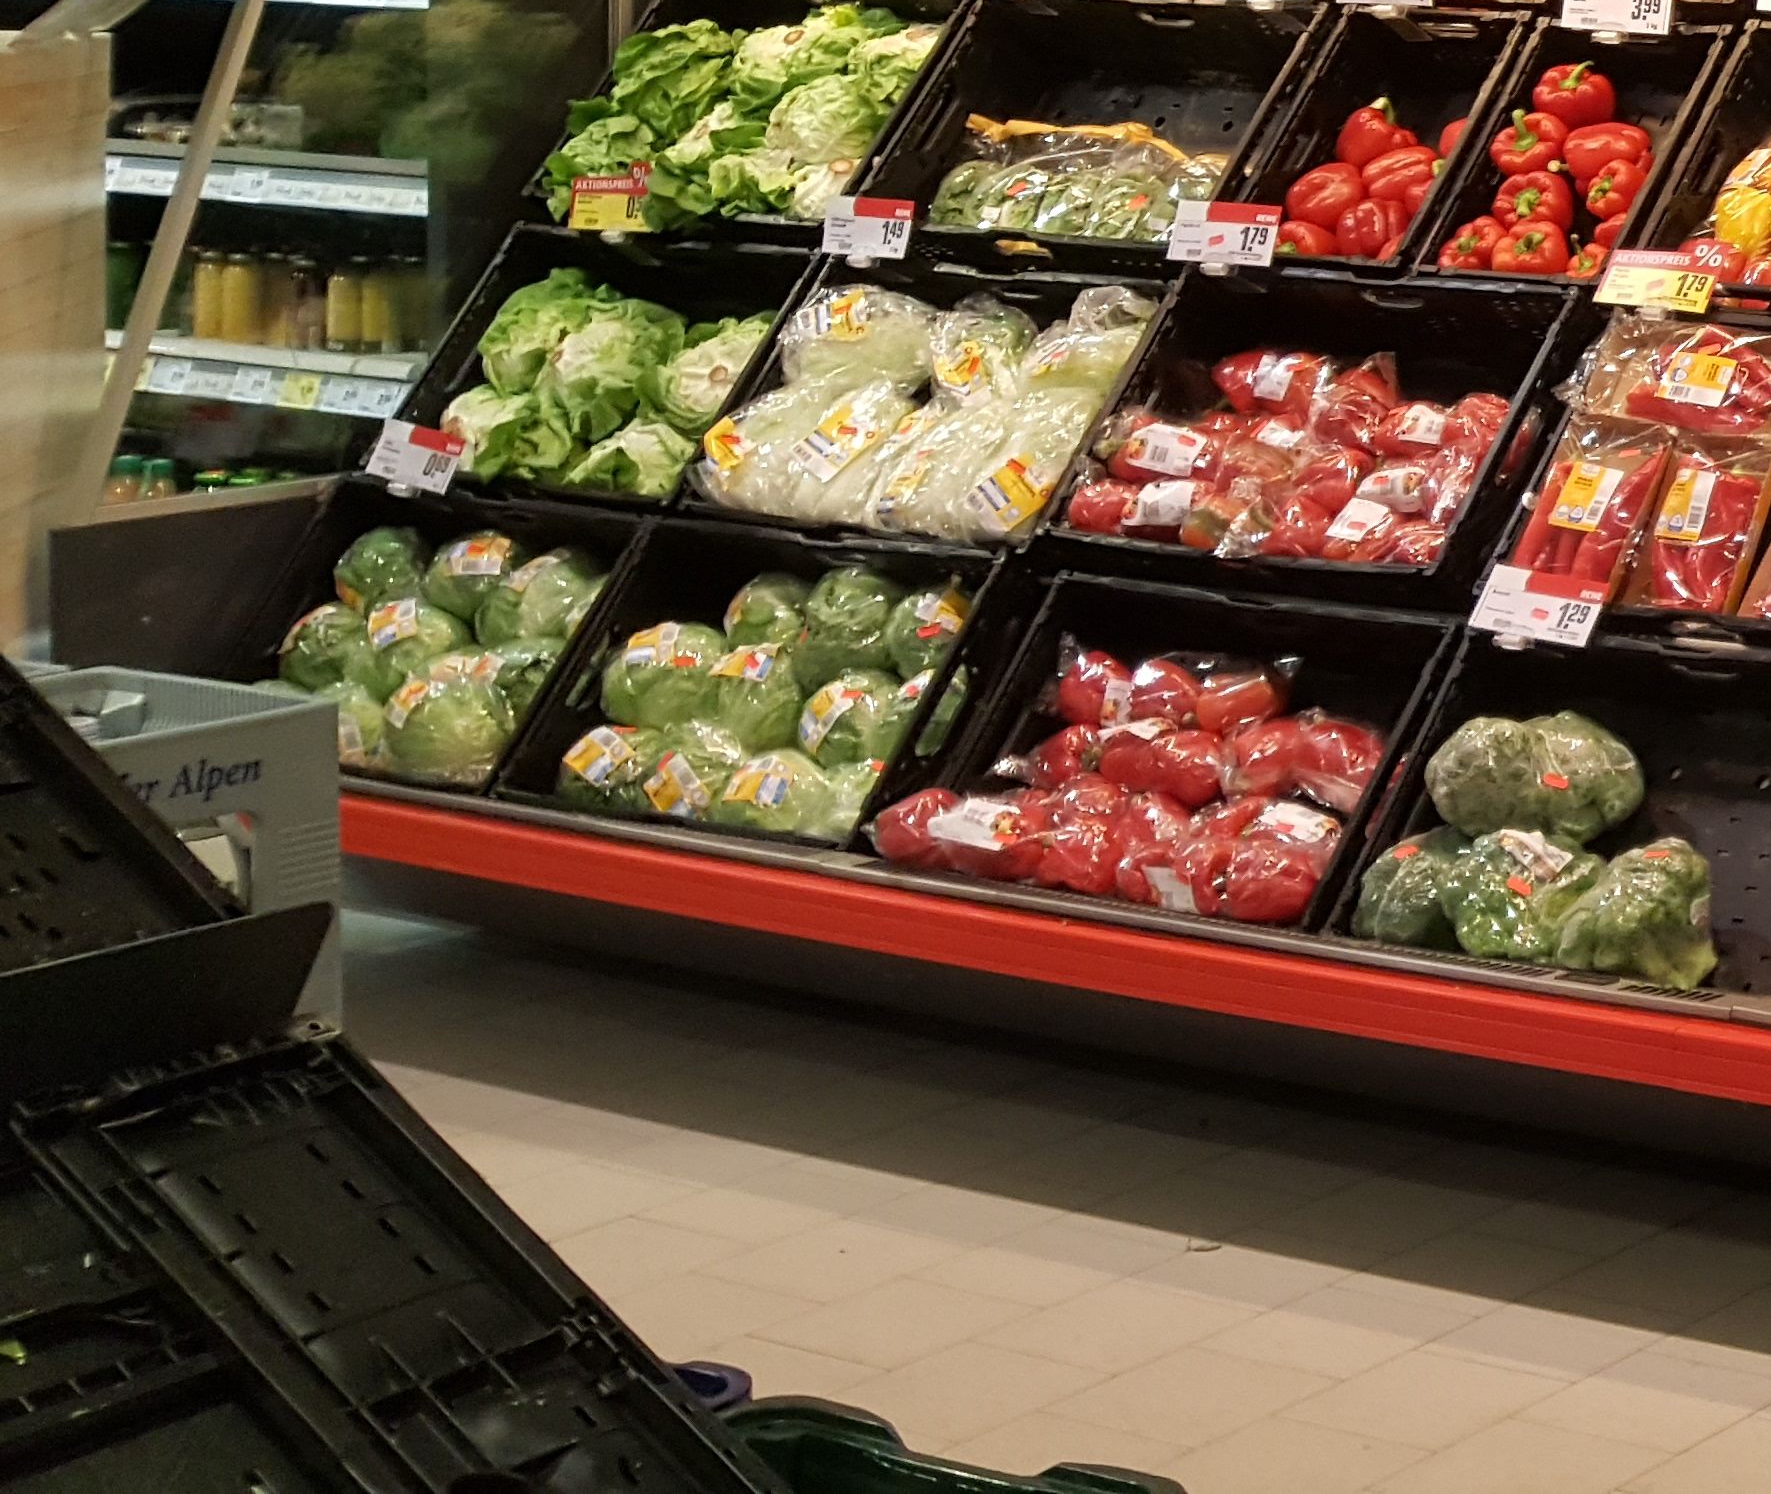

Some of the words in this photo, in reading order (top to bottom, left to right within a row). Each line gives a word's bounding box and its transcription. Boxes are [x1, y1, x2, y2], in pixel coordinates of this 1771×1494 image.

[1240, 226, 1269, 252] 1.79
[1614, 254, 1692, 266] AKTIONSPREIS
[1695, 245, 1723, 267] %
[1675, 273, 1708, 298] 1.79
[1559, 602, 1591, 629] 1.29
[168, 758, 262, 803] Alpen
